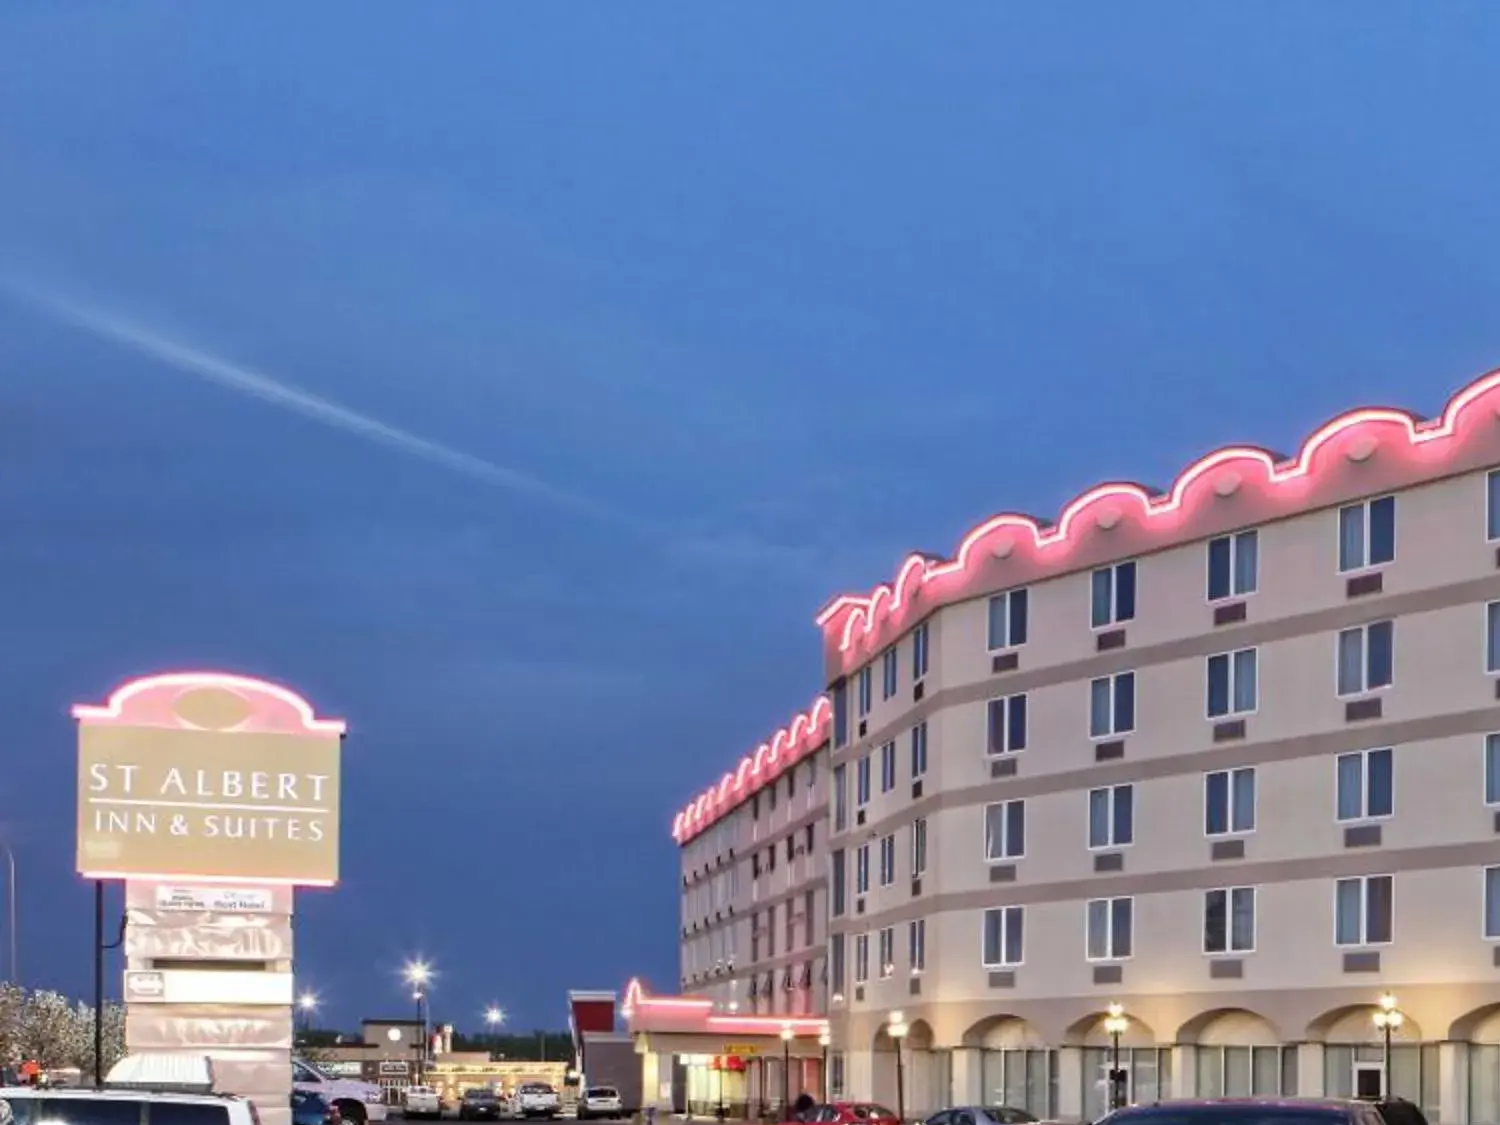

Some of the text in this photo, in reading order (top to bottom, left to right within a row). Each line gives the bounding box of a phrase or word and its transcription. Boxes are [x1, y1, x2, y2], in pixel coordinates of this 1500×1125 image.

[89, 763, 330, 801] ST ALBERT
[95, 810, 324, 842] INN & SUITES
